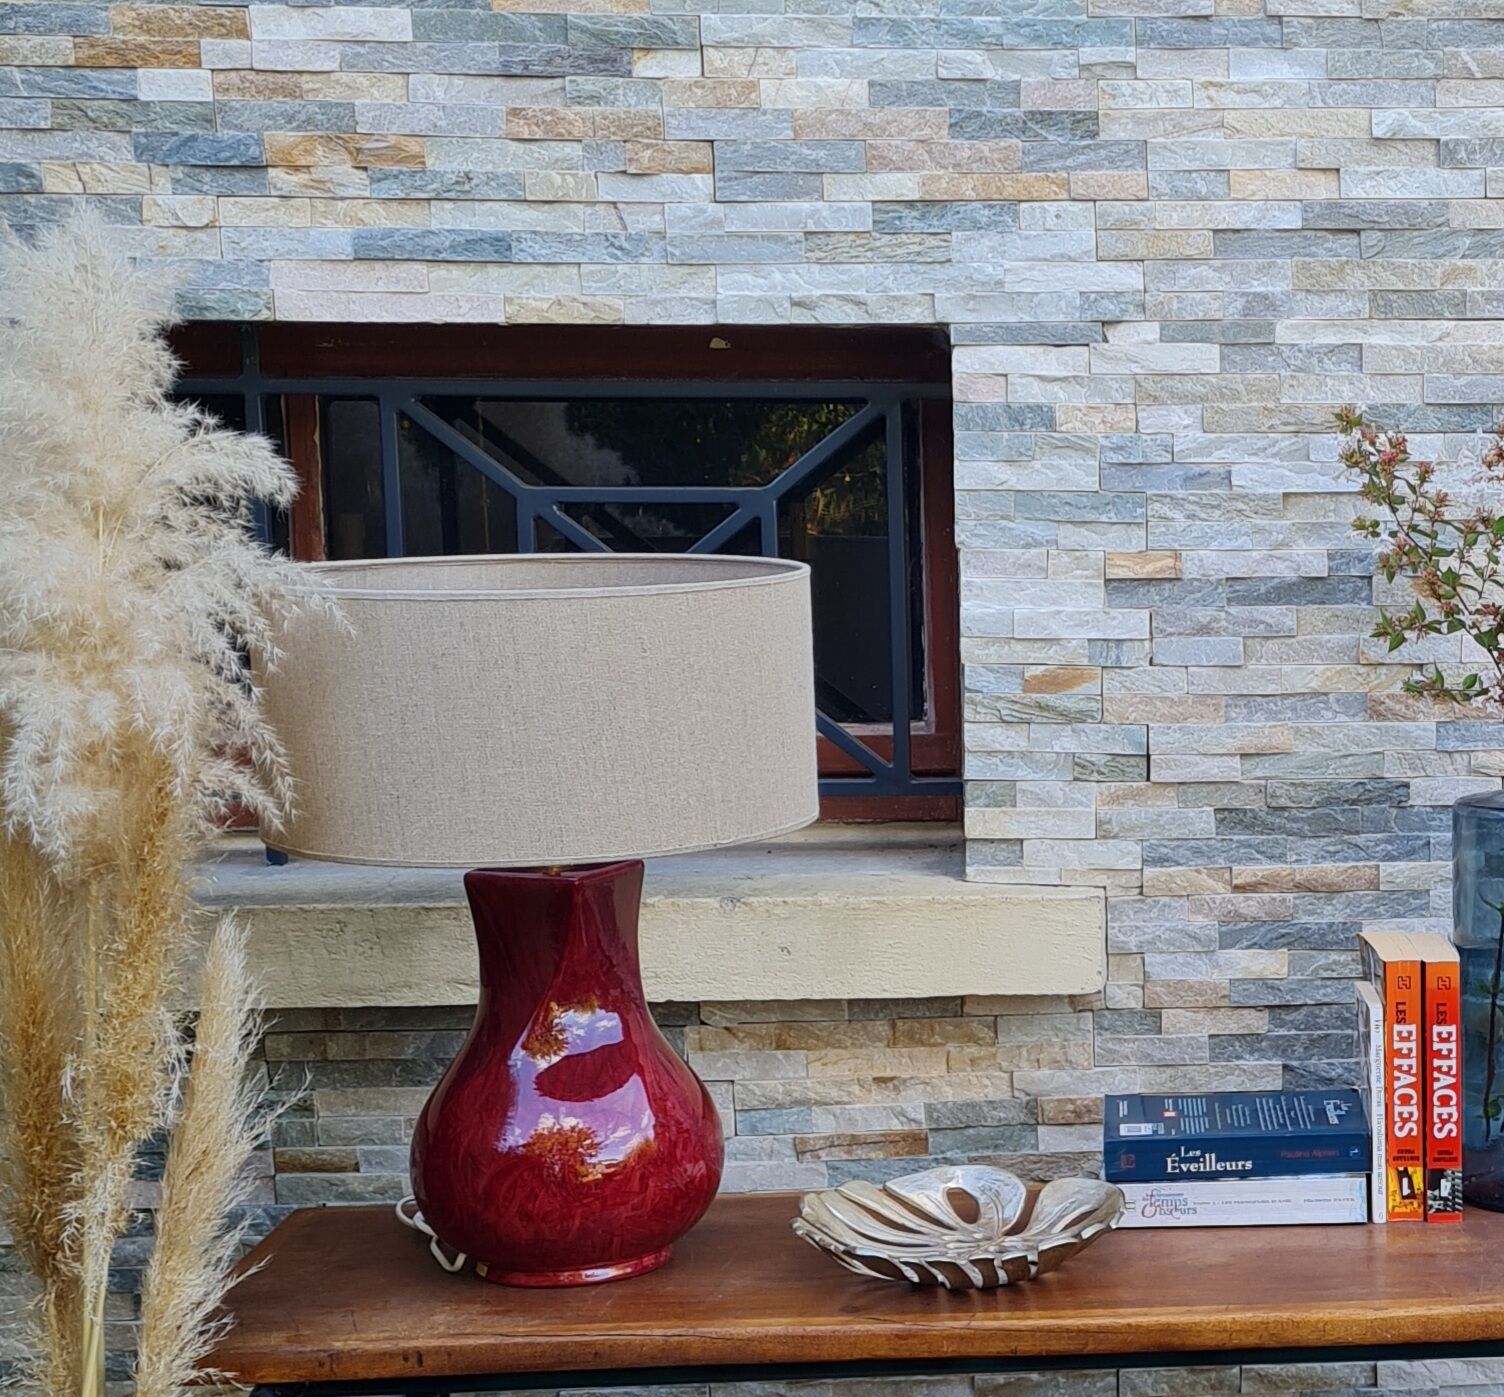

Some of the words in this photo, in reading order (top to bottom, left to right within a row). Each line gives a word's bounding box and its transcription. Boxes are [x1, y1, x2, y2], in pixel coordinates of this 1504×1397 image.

[1396, 1001, 1406, 1024] LES
[1436, 1003, 1447, 1025] LES
[1180, 1145, 1201, 1157] Les
[1166, 1152, 1253, 1173] Éveilleurs
